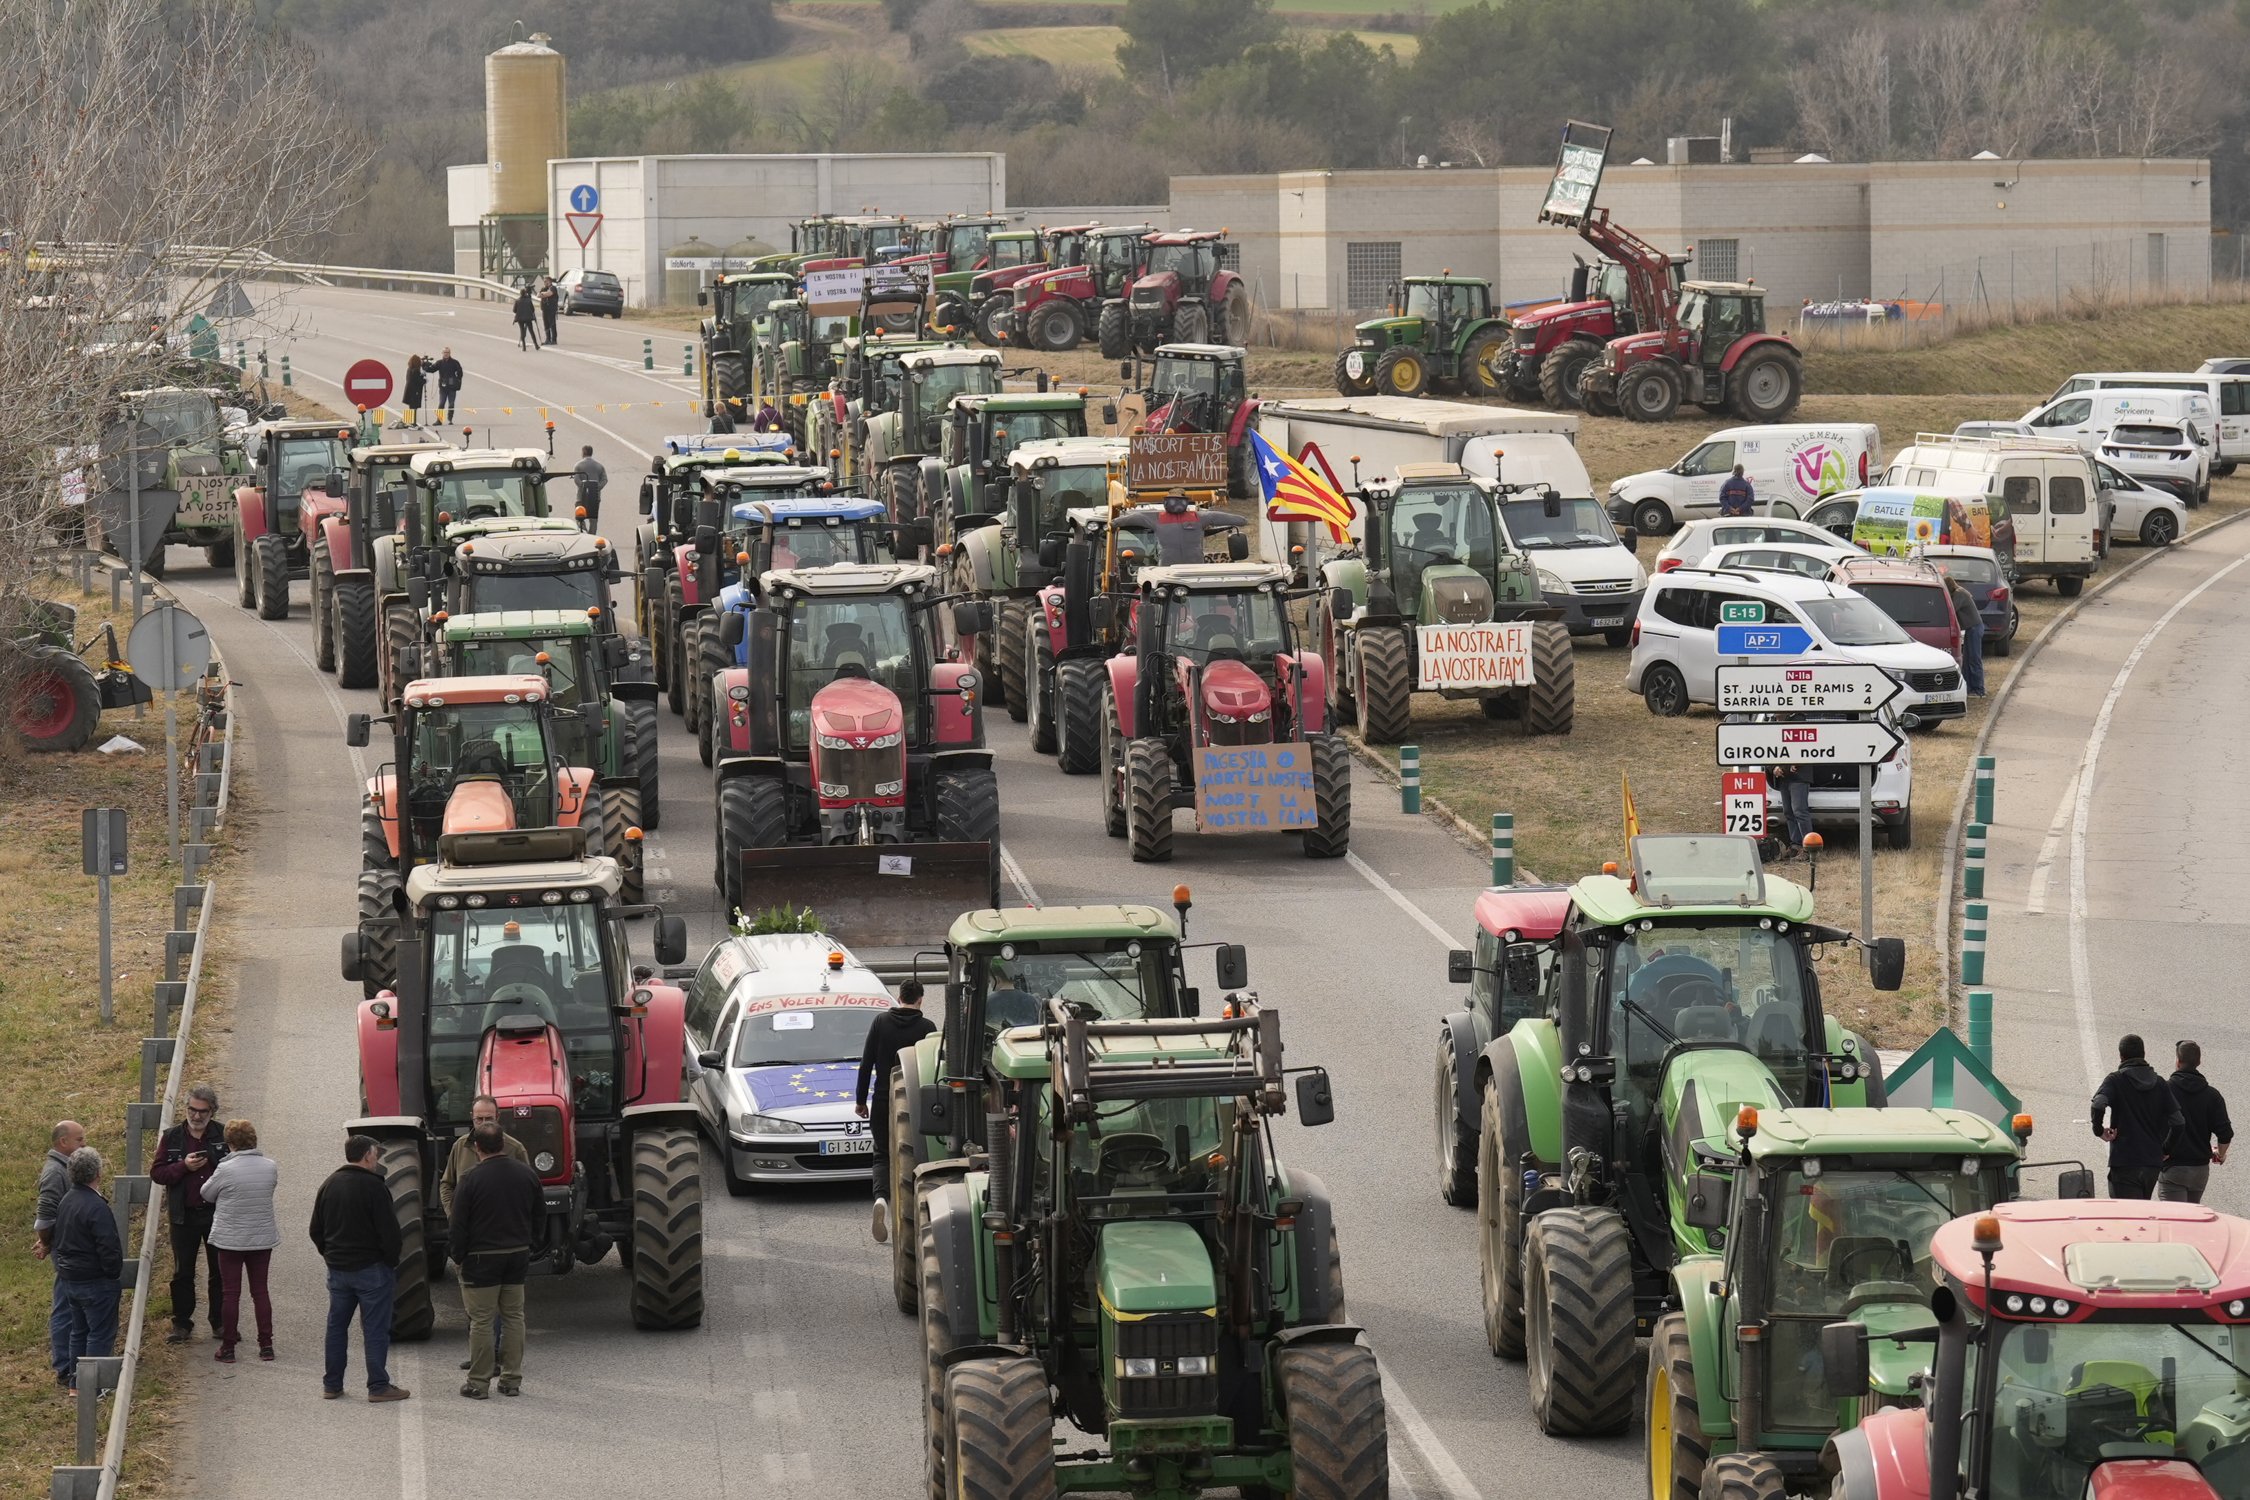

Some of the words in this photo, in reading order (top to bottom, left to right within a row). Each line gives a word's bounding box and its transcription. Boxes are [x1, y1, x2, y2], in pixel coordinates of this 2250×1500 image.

[826, 288, 848, 296] VOSTRA
[2114, 407, 2154, 415] Servicentre
[1785, 431, 1844, 454] VALLEMENA
[1132, 463, 1144, 481] LA
[177, 479, 193, 493] LA
[198, 476, 249, 490] NOSTRA
[198, 500, 238, 511] VOSTR
[1874, 505, 1906, 516] BATLLE
[202, 513, 229, 524] FAM
[1729, 607, 1757, 618] E-15
[1426, 632, 1444, 652] LA
[1448, 630, 1505, 652] NOSTRA
[1747, 635, 1778, 646] AP-7
[1424, 658, 1442, 682] LA
[1442, 656, 1498, 681] VOSTRA
[1499, 656, 1525, 680] FAM
[1723, 685, 1742, 694] ST.
[1749, 682, 1784, 694] JULIÀ
[1791, 684, 1807, 693] DE
[1814, 683, 1854, 693] RAMIS
[1864, 683, 1872, 693] 2
[1777, 697, 1793, 706] DE
[1801, 696, 1824, 705] TER
[1863, 696, 1872, 705] 4
[1724, 746, 1790, 759] GIRONA
[1800, 745, 1835, 758] nord
[1867, 745, 1876, 757] 7
[1277, 751, 1295, 768] O
[1734, 777, 1754, 790] N-II
[1734, 798, 1754, 809] km
[1726, 814, 1763, 833] 725
[749, 1001, 773, 1013] ENS
[778, 996, 826, 1009] VOLEN
[834, 994, 891, 1008] MORTS
[844, 1140, 872, 1152] 3147
